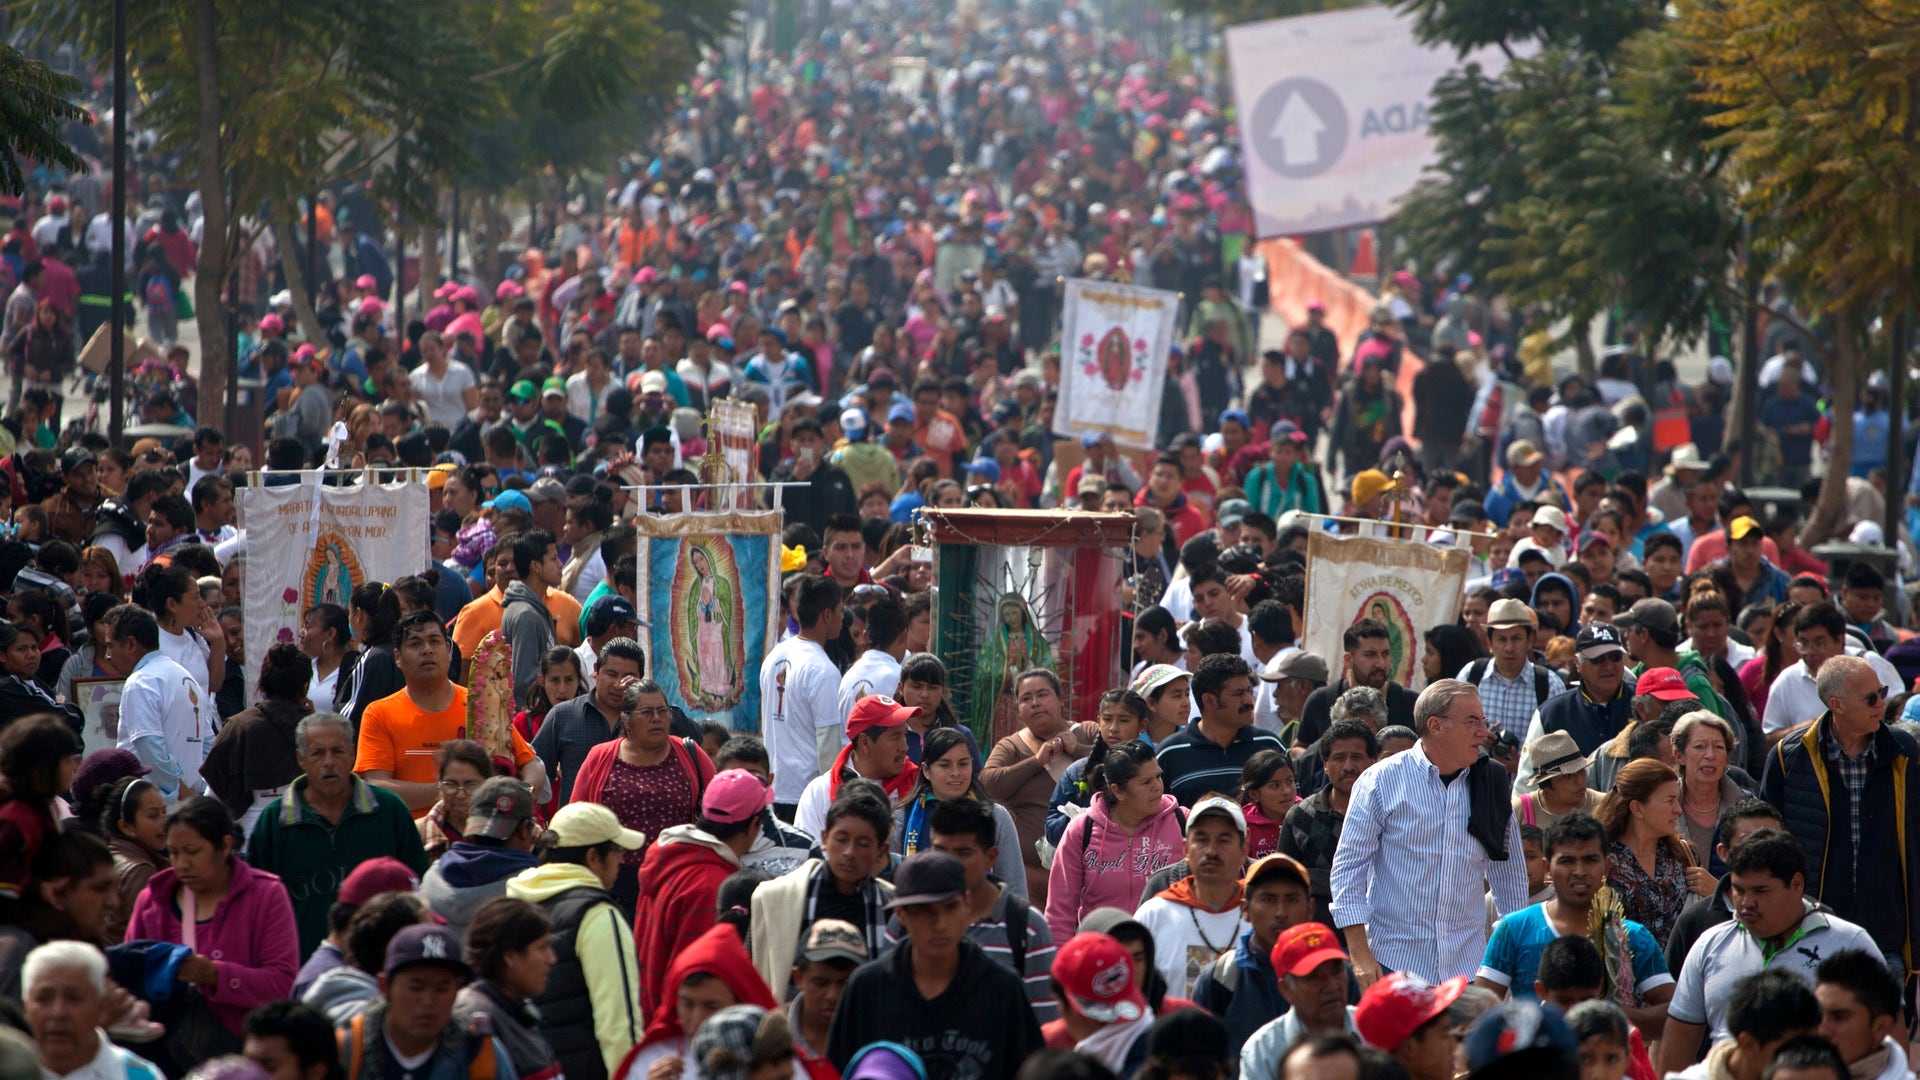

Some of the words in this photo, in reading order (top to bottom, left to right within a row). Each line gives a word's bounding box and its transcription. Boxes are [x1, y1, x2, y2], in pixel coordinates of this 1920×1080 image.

[1379, 575, 1392, 587] DE
[1591, 626, 1613, 640] LA
[1083, 849, 1127, 875] Royal
